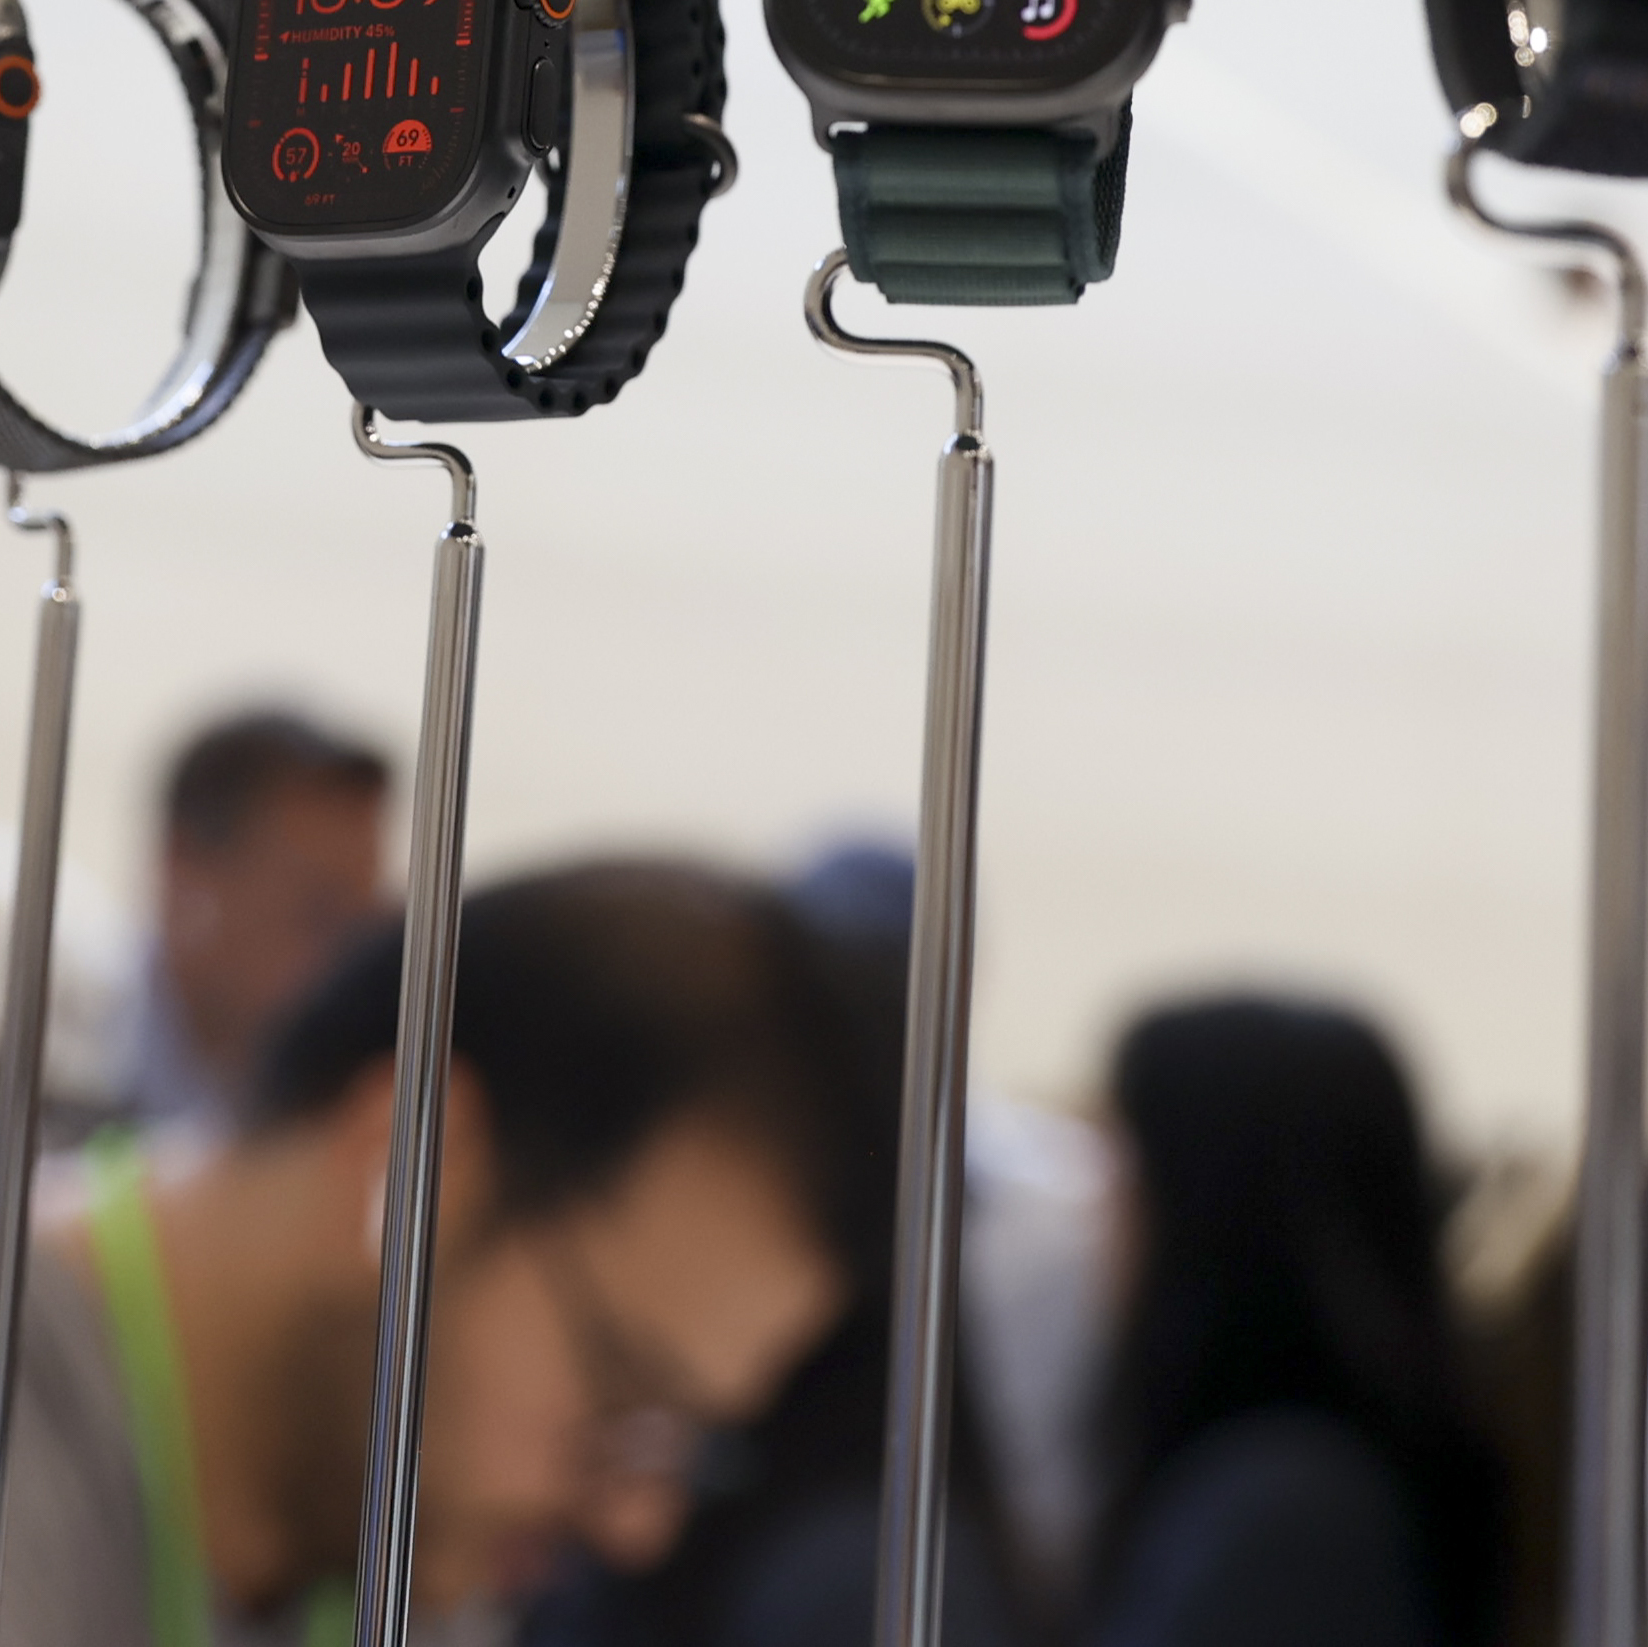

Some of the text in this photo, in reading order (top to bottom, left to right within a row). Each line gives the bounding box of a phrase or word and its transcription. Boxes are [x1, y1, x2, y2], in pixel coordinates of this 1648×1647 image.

[291, 23, 395, 43] HUMIDITY 45%
[396, 129, 419, 147] 69
[286, 147, 308, 165] 57
[341, 141, 362, 156] 20
[398, 155, 414, 167] FT
